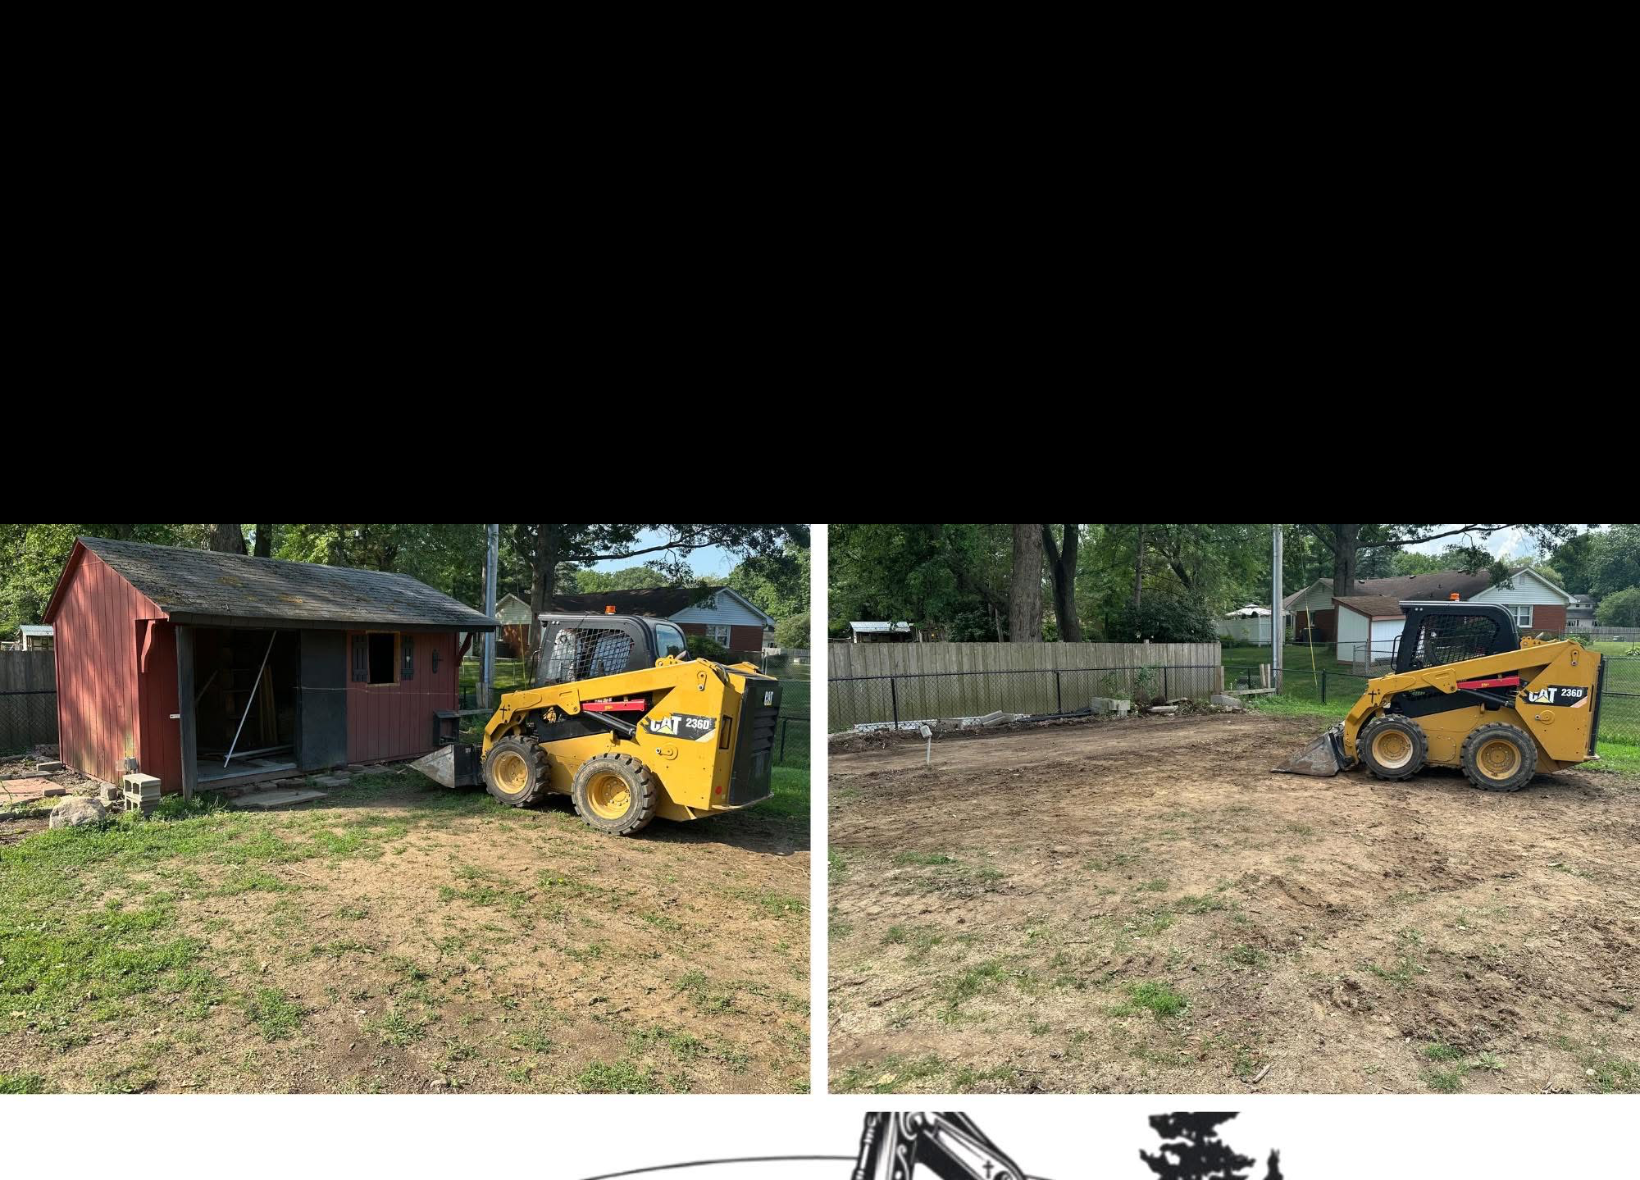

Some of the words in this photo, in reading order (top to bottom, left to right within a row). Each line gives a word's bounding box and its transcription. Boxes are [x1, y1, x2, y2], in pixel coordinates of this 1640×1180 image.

[763, 691, 774, 706] CAT
[1528, 687, 1558, 704] CAT
[1561, 688, 1583, 698] 236D
[650, 715, 682, 735] CAT
[685, 717, 711, 730] 236D
